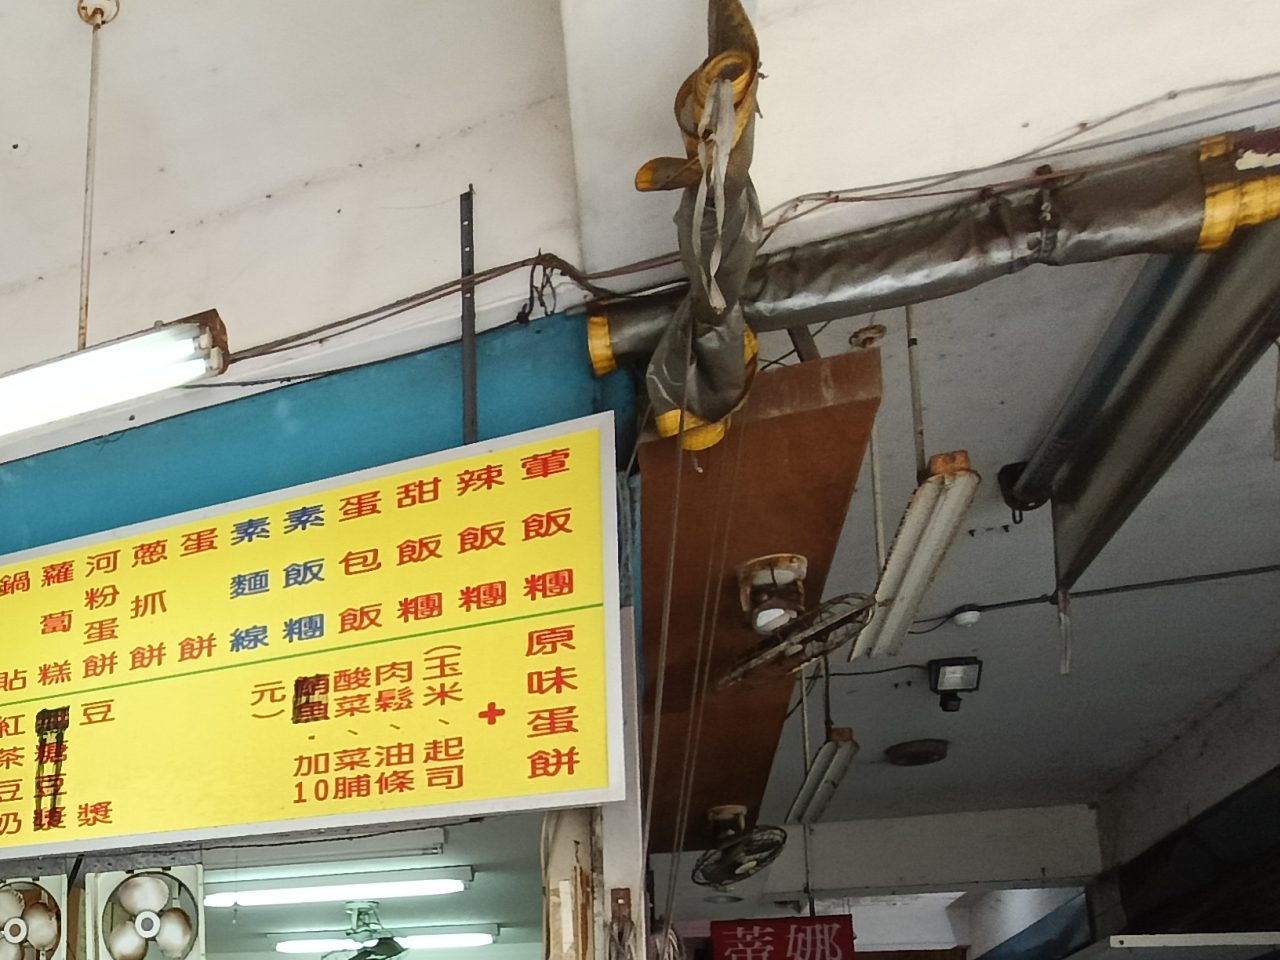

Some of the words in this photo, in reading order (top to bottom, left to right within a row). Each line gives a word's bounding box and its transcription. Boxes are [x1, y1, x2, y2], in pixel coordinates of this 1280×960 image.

[229, 516, 271, 653] 素麵線
[282, 504, 326, 644] 素飯糰
[339, 490, 382, 634] 蛋包飯
[396, 477, 443, 622] 甜飯糰
[457, 464, 507, 613] 辣飯糰
[521, 448, 573, 600] 葷飯糰
[38, 559, 76, 688] 蘿蔔糕
[82, 549, 121, 678] 河粉蛋餅
[178, 527, 218, 662] 蛋餅
[77, 699, 116, 827] 豆漿
[525, 624, 580, 780] 原味蛋餅
